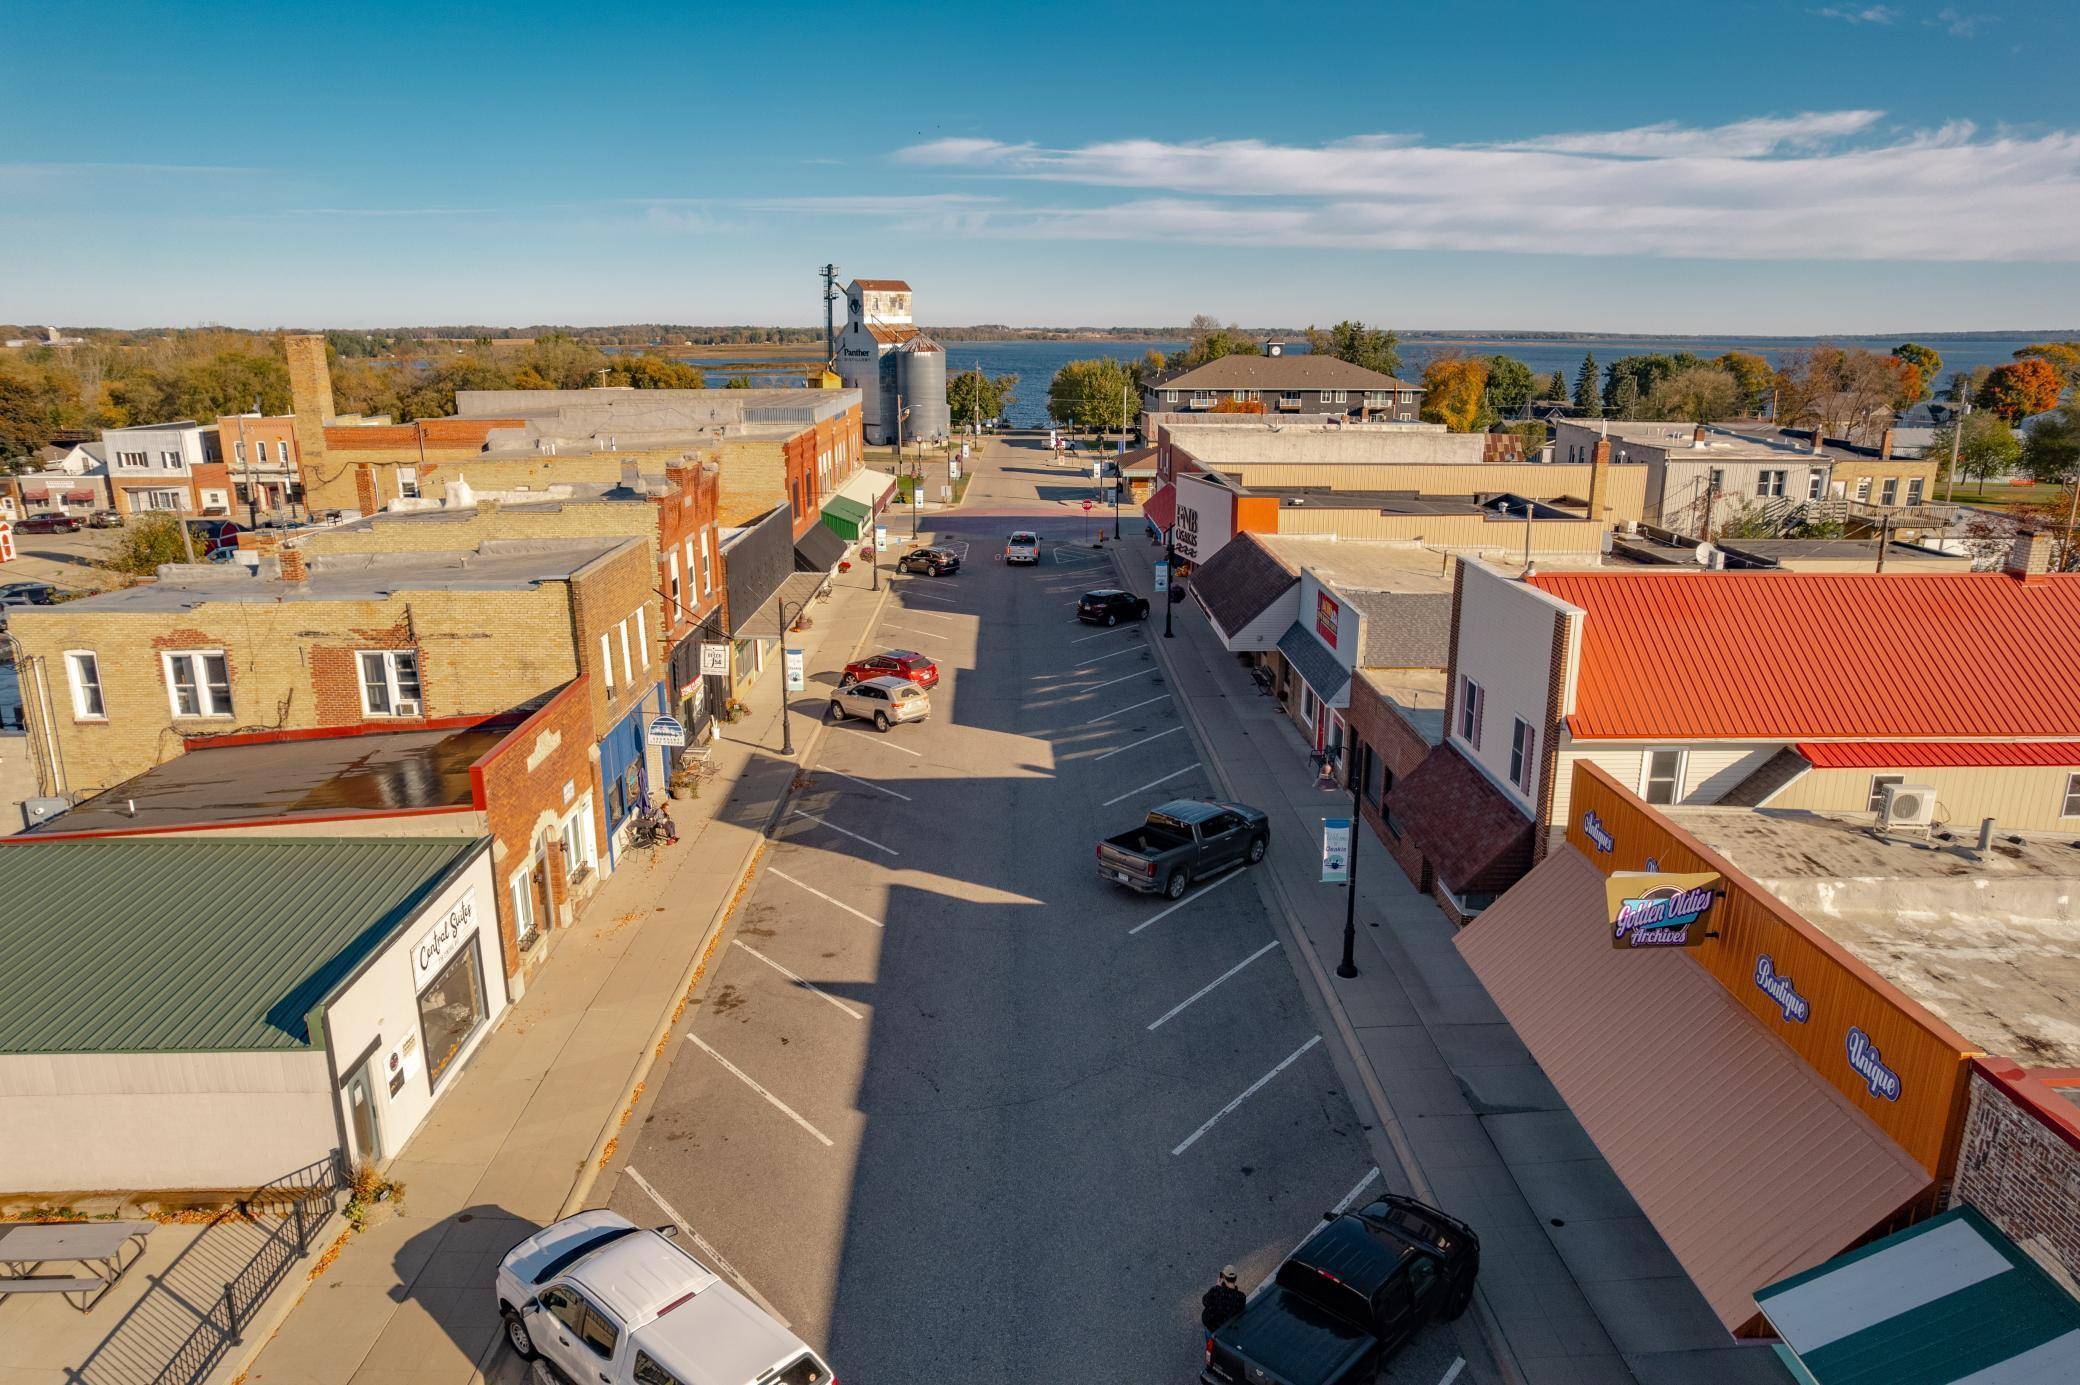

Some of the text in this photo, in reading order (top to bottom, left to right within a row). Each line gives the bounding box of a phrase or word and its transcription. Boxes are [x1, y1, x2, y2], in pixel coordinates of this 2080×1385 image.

[844, 348, 870, 357] Panther
[1177, 504, 1198, 533] FNB
[1176, 528, 1197, 547] OSAKIS
[1585, 815, 1612, 849] Antiques
[1616, 888, 1712, 937] Golden Oldies
[420, 921, 450, 971] Central
[450, 900, 472, 938] Suites
[1631, 926, 1687, 945] Archives
[1756, 958, 1805, 1018] Boutique
[1849, 1032, 1896, 1096] Unique
